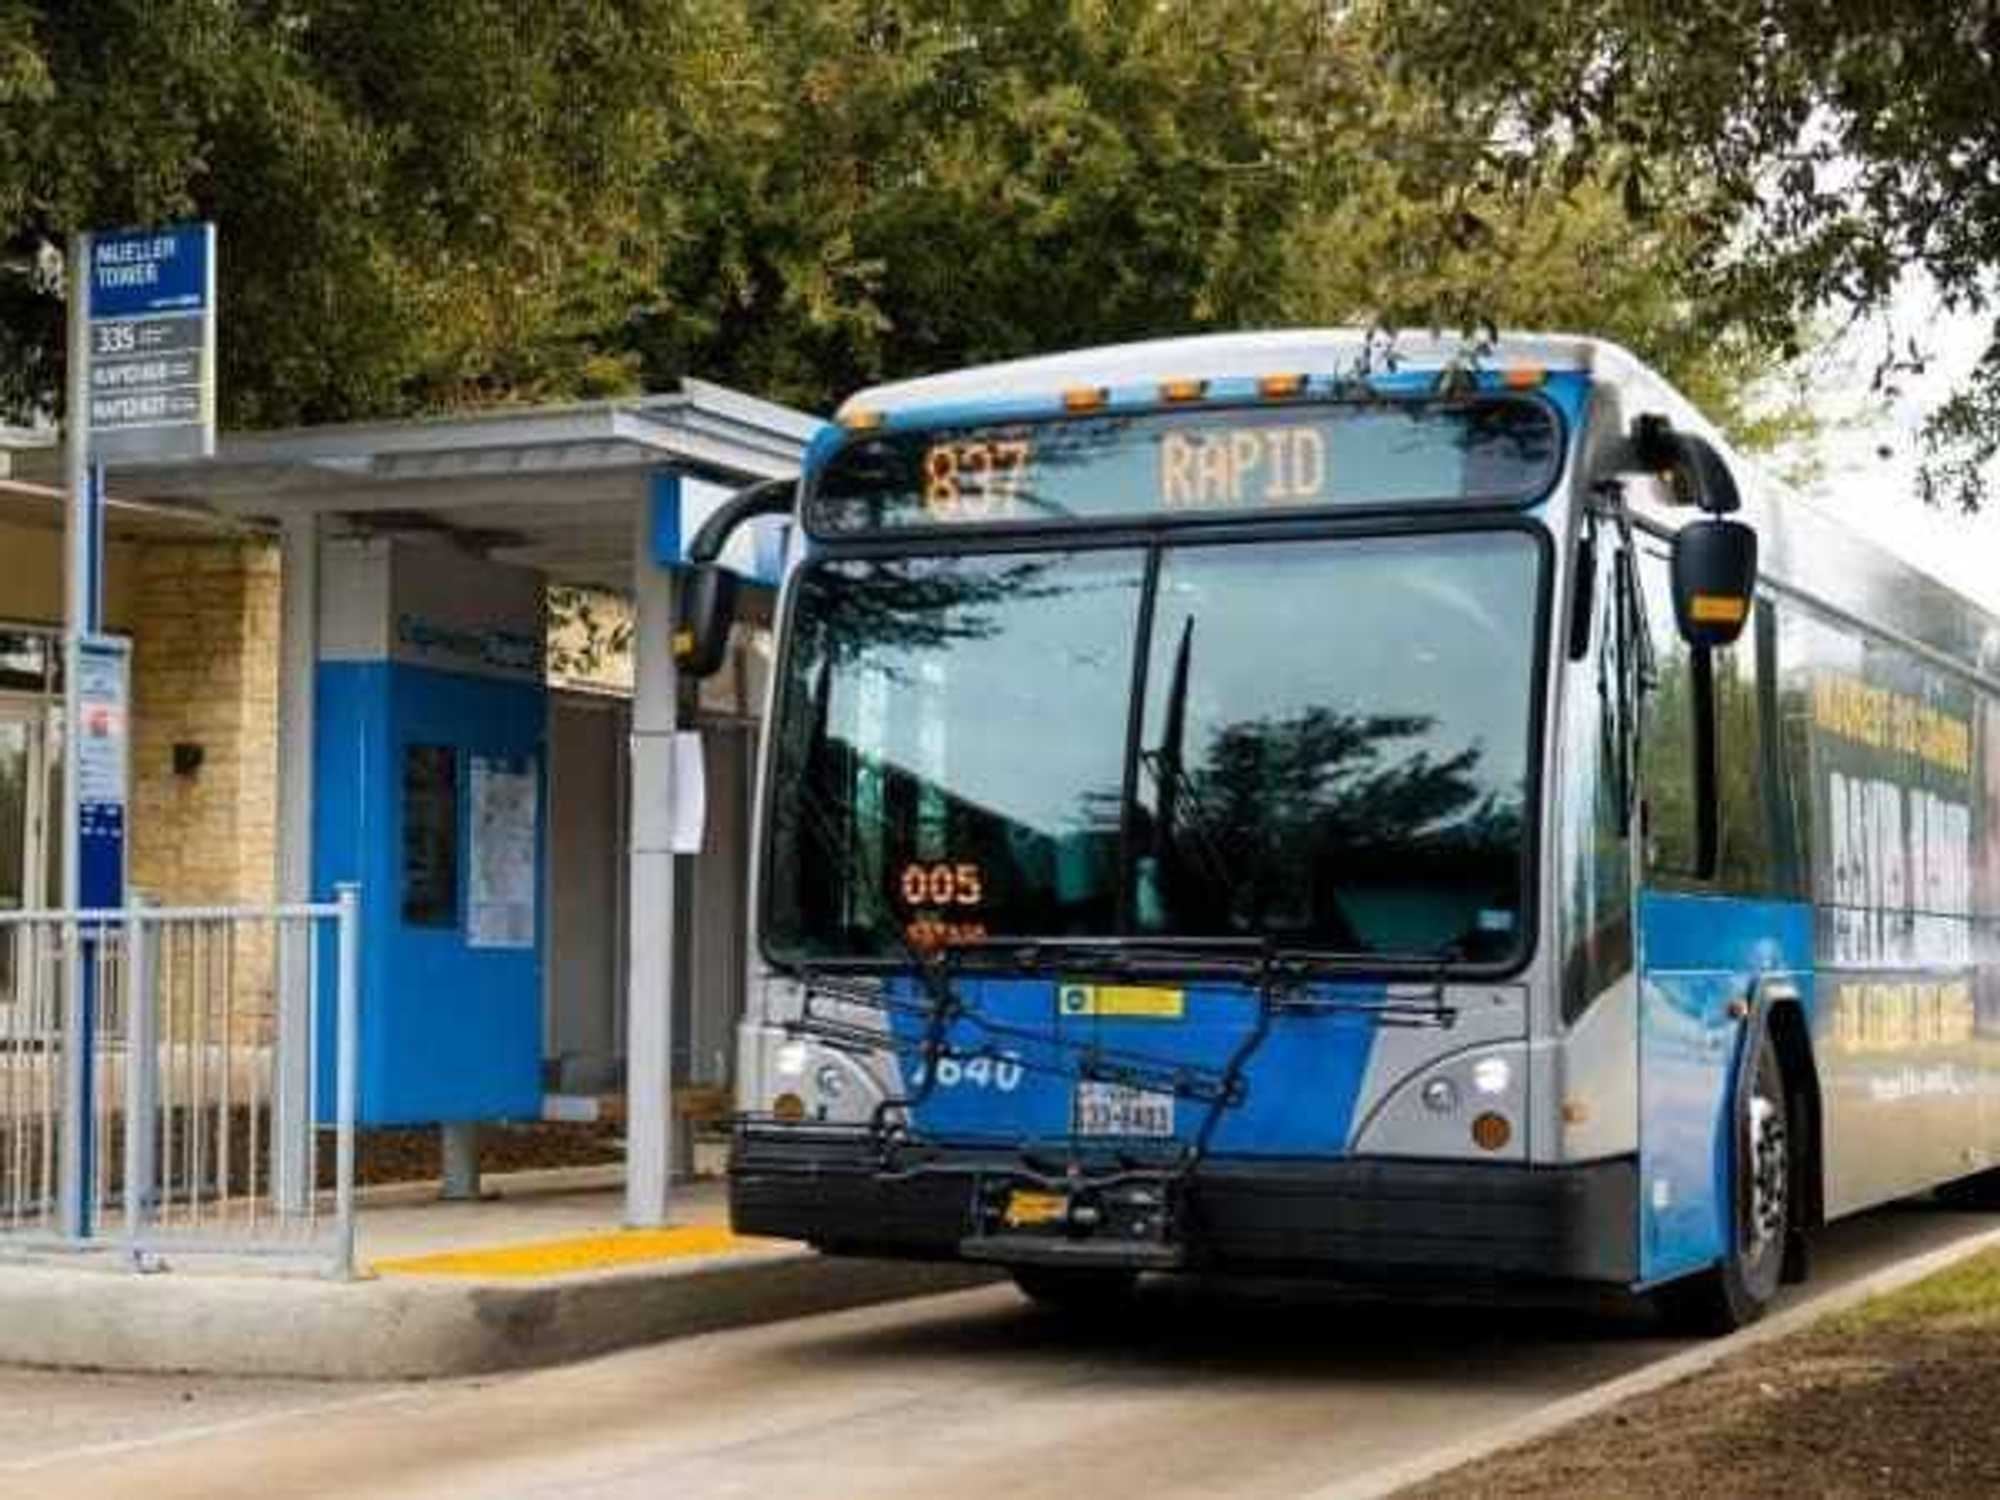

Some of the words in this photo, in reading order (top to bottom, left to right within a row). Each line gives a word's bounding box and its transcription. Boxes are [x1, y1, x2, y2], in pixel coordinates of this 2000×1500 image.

[96, 262, 160, 288] TOWER
[924, 441, 1030, 521] 837
[1160, 427, 1329, 508] RAPID
[902, 864, 982, 905] 005
